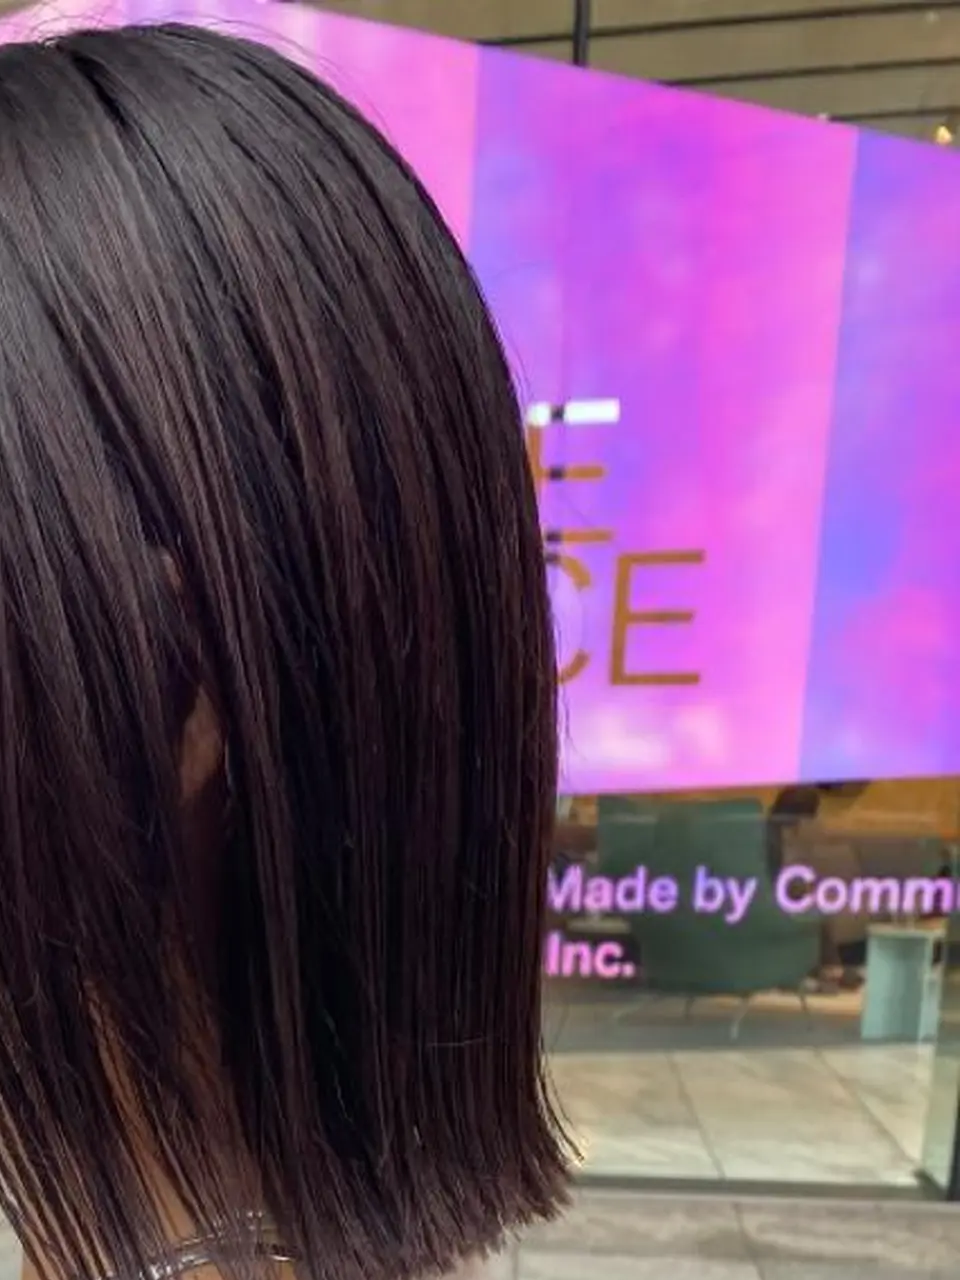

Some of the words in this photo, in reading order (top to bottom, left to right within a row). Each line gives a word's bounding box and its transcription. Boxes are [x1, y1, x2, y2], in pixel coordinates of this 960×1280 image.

[546, 864, 678, 913] Made
[694, 864, 758, 924] by
[776, 863, 960, 914] Comm
[545, 931, 635, 978] Inc.
